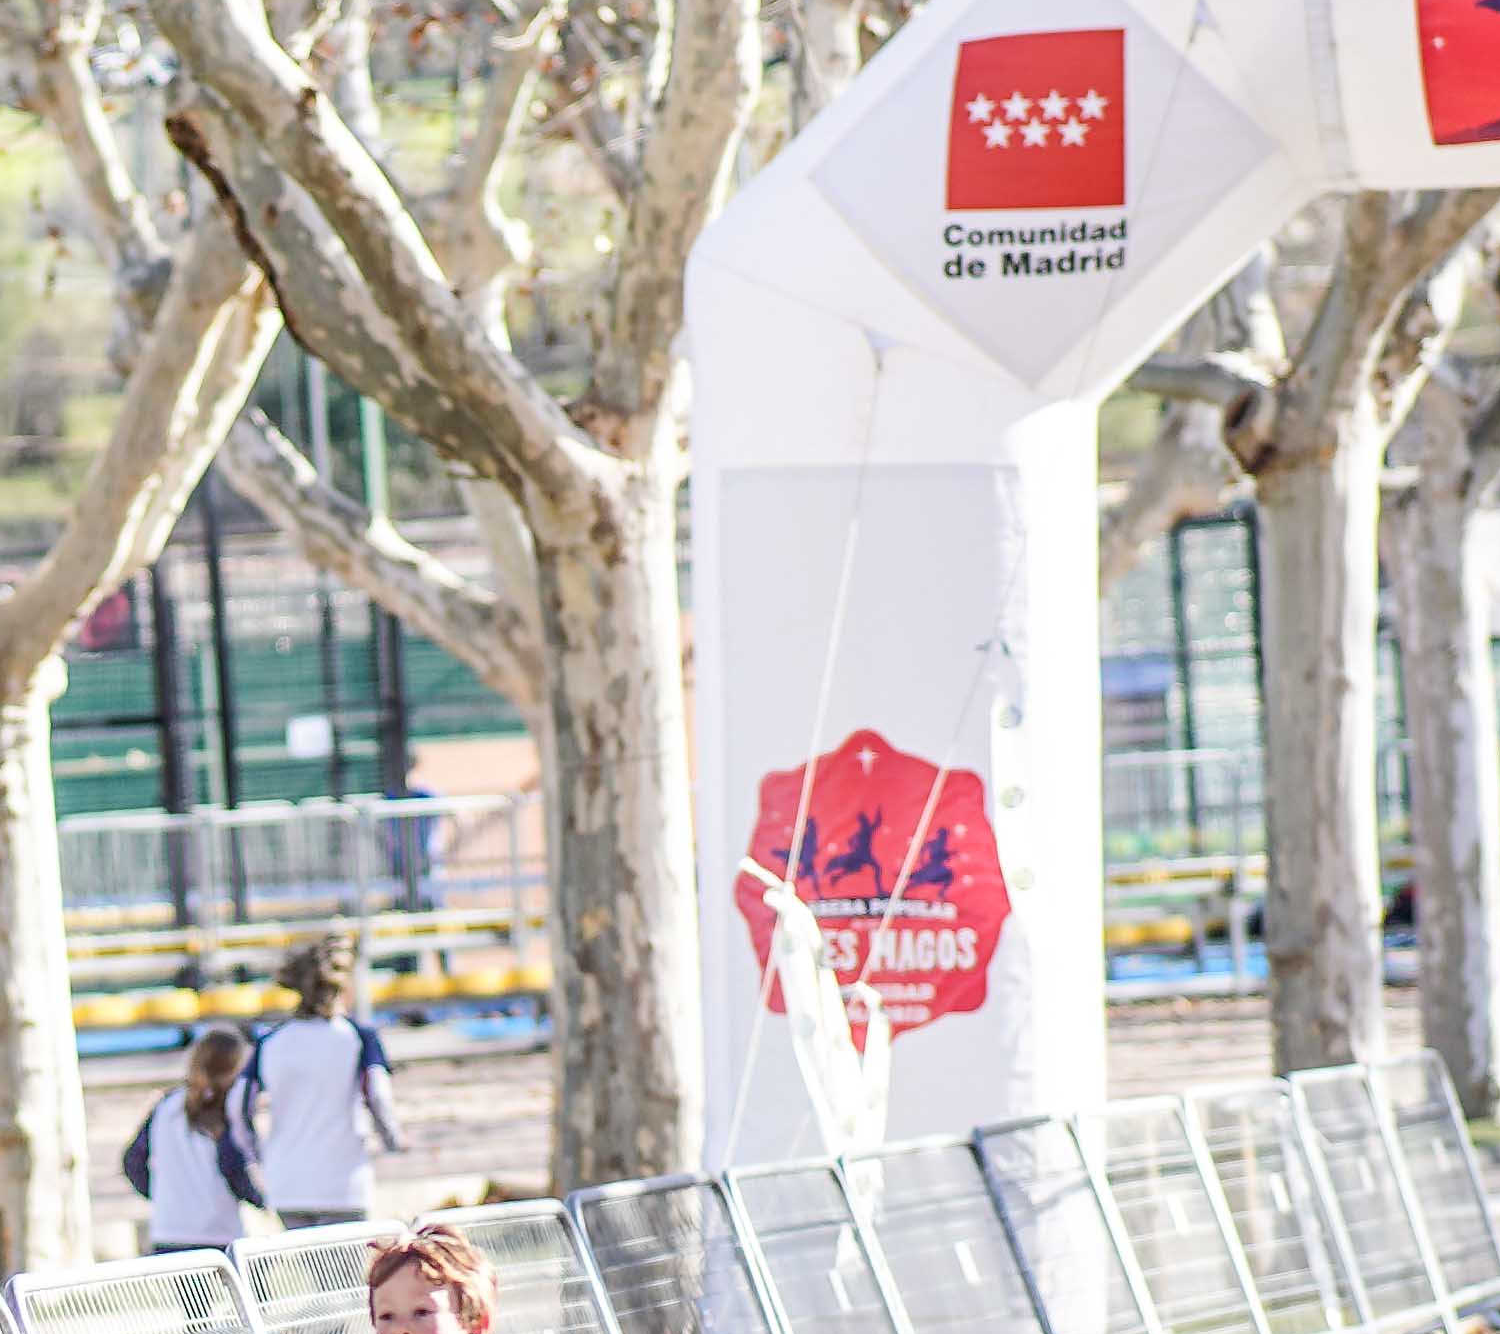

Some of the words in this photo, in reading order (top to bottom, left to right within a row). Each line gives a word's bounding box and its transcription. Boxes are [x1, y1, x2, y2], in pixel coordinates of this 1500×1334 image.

[942, 219, 1128, 248] Comunidad
[943, 252, 986, 279] de
[1001, 247, 1126, 278] Madrid
